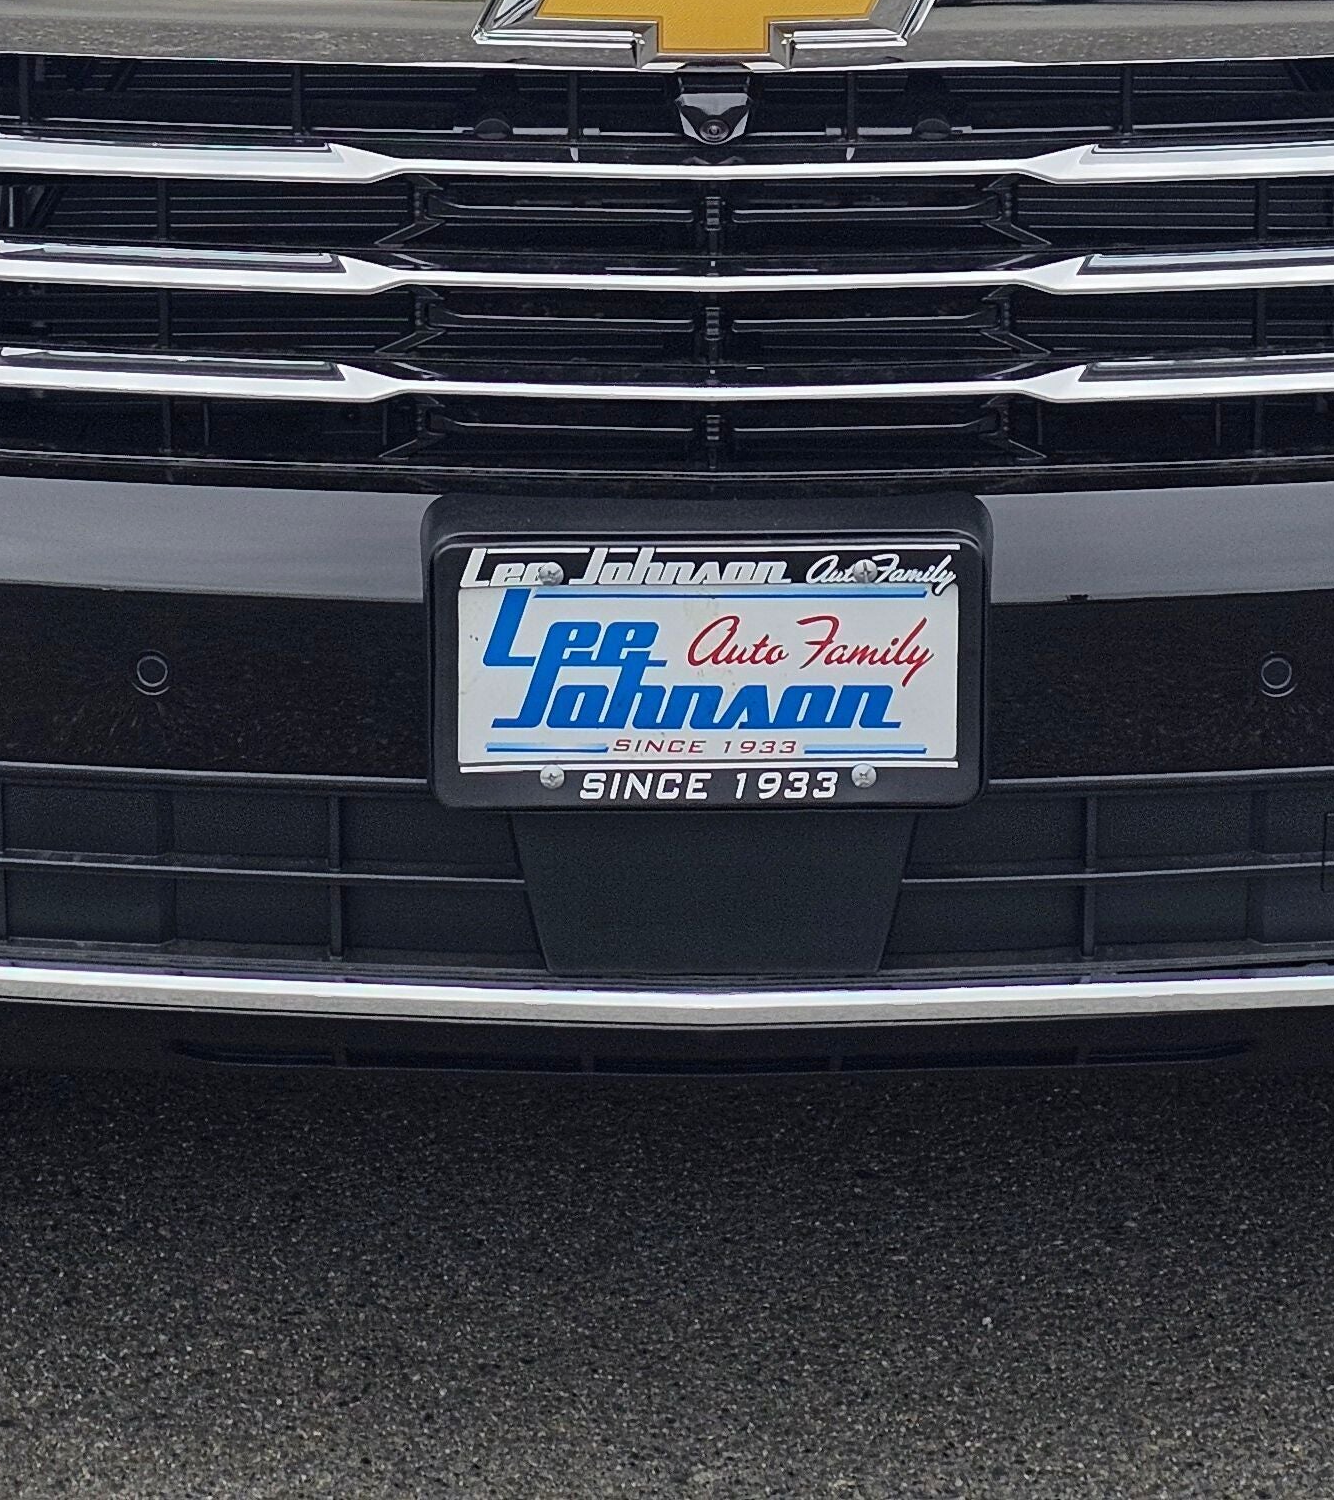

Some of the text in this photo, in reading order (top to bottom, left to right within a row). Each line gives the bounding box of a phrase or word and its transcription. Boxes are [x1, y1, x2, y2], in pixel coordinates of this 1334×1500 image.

[569, 547, 791, 585] Johnson
[805, 554, 878, 583] Aut
[871, 553, 957, 595] Family
[482, 588, 667, 666] Lee
[687, 615, 934, 687] Auto Family
[491, 658, 901, 729] Johnson
[613, 739, 797, 754] SINCE 1933
[579, 772, 838, 800] SINCE 1933
